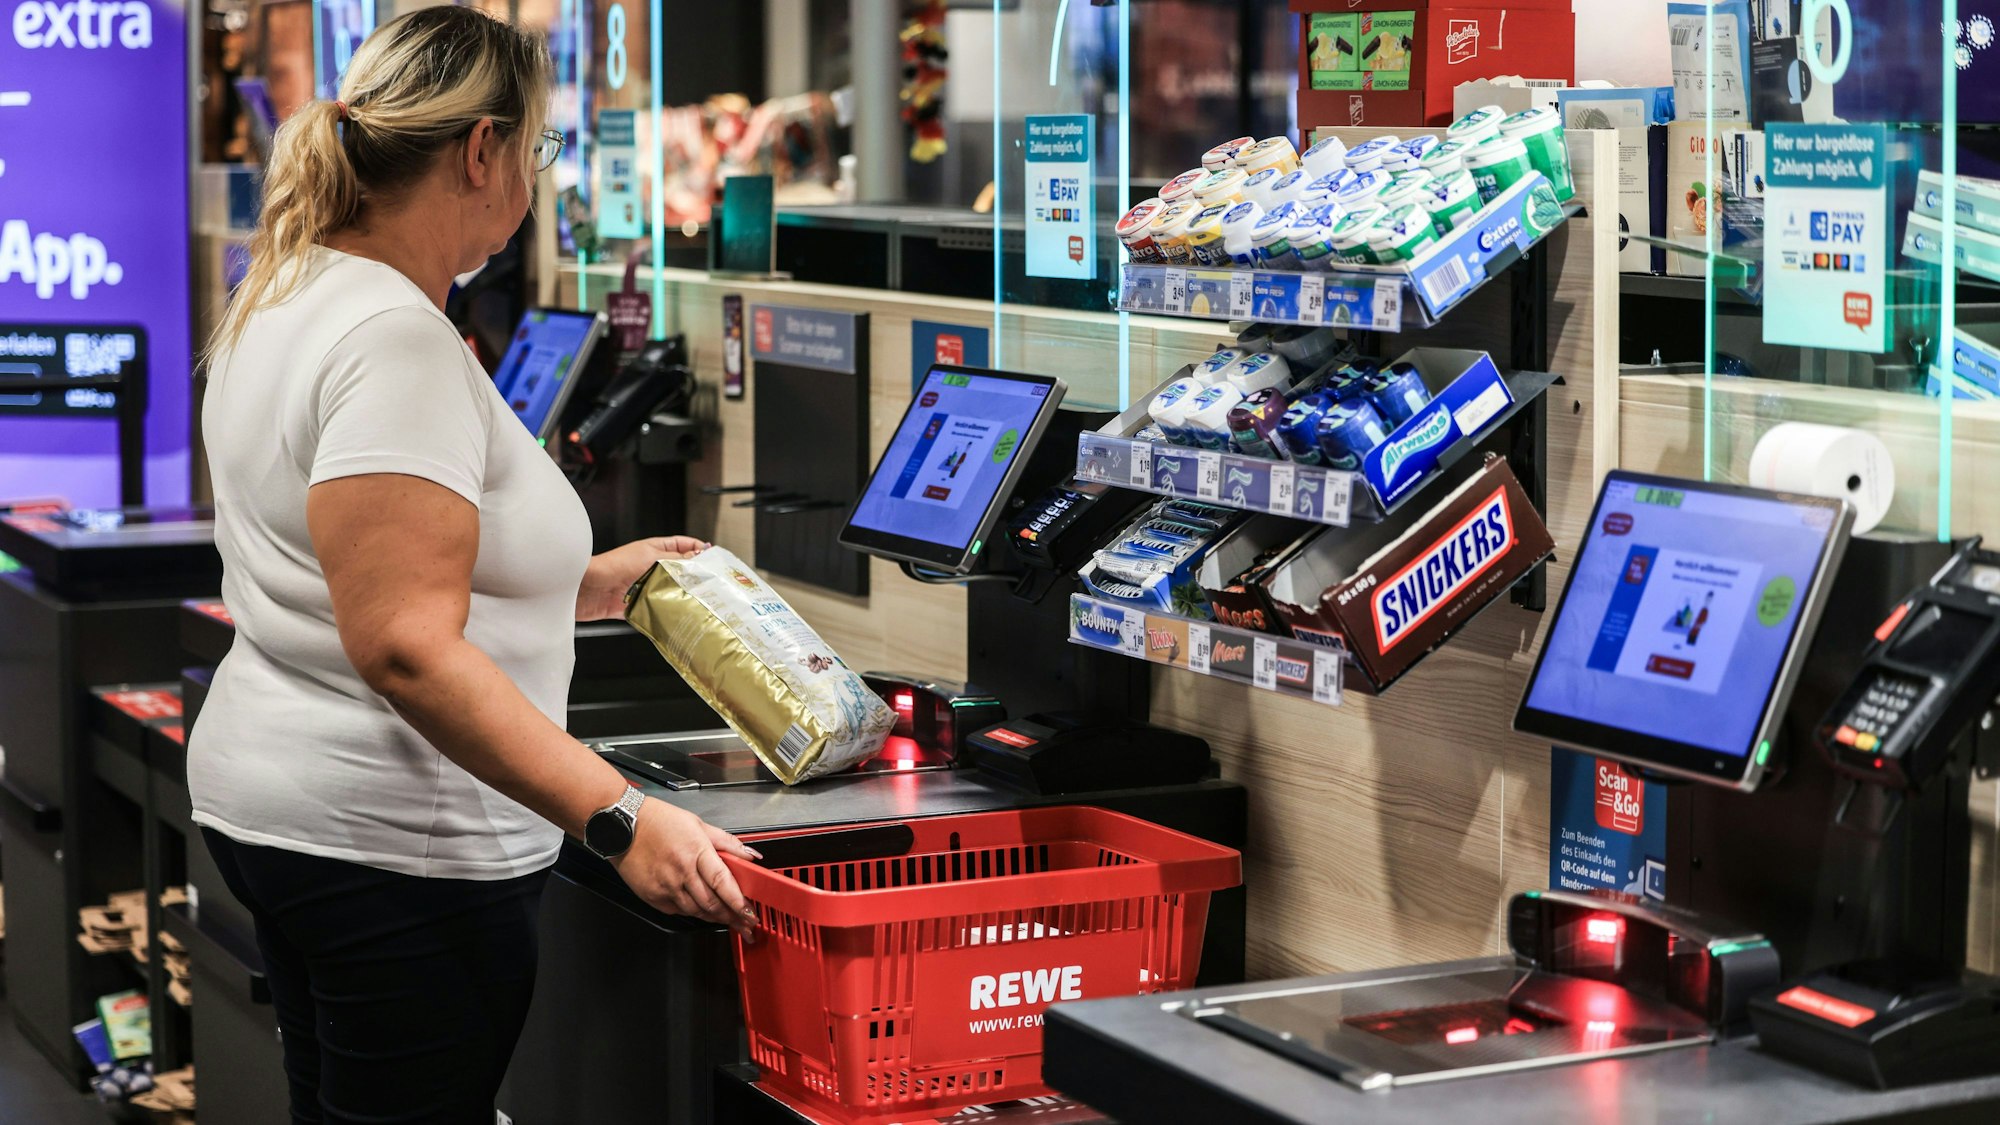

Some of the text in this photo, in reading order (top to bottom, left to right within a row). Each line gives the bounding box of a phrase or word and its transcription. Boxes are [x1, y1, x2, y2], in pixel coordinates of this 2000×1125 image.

[13, 0, 152, 49] extra
[607, 3, 627, 90] 8
[1773, 132, 1874, 156] Hier nur bargeldlose
[1773, 156, 1813, 181] Zahlung
[1815, 157, 1859, 182] möglich.
[1061, 186, 1079, 202] PAY
[1832, 211, 1865, 221] PAYBACK
[1478, 215, 1519, 250] extra
[1832, 223, 1864, 243] PAY
[0, 219, 124, 300] App.
[1382, 503, 1505, 638] SNICKERS
[1081, 611, 1117, 634] BOUNTY
[1211, 640, 1246, 664] Mars
[1599, 766, 1628, 792] Scan
[1613, 792, 1640, 817] &Go
[1561, 827, 1606, 849] Zum Beenden
[1561, 844, 1616, 868] des Einkaufs den
[1561, 859, 1616, 884] QR-Code auf dem
[970, 965, 1083, 1011] REWE
[969, 1013, 1045, 1034] www.rew
